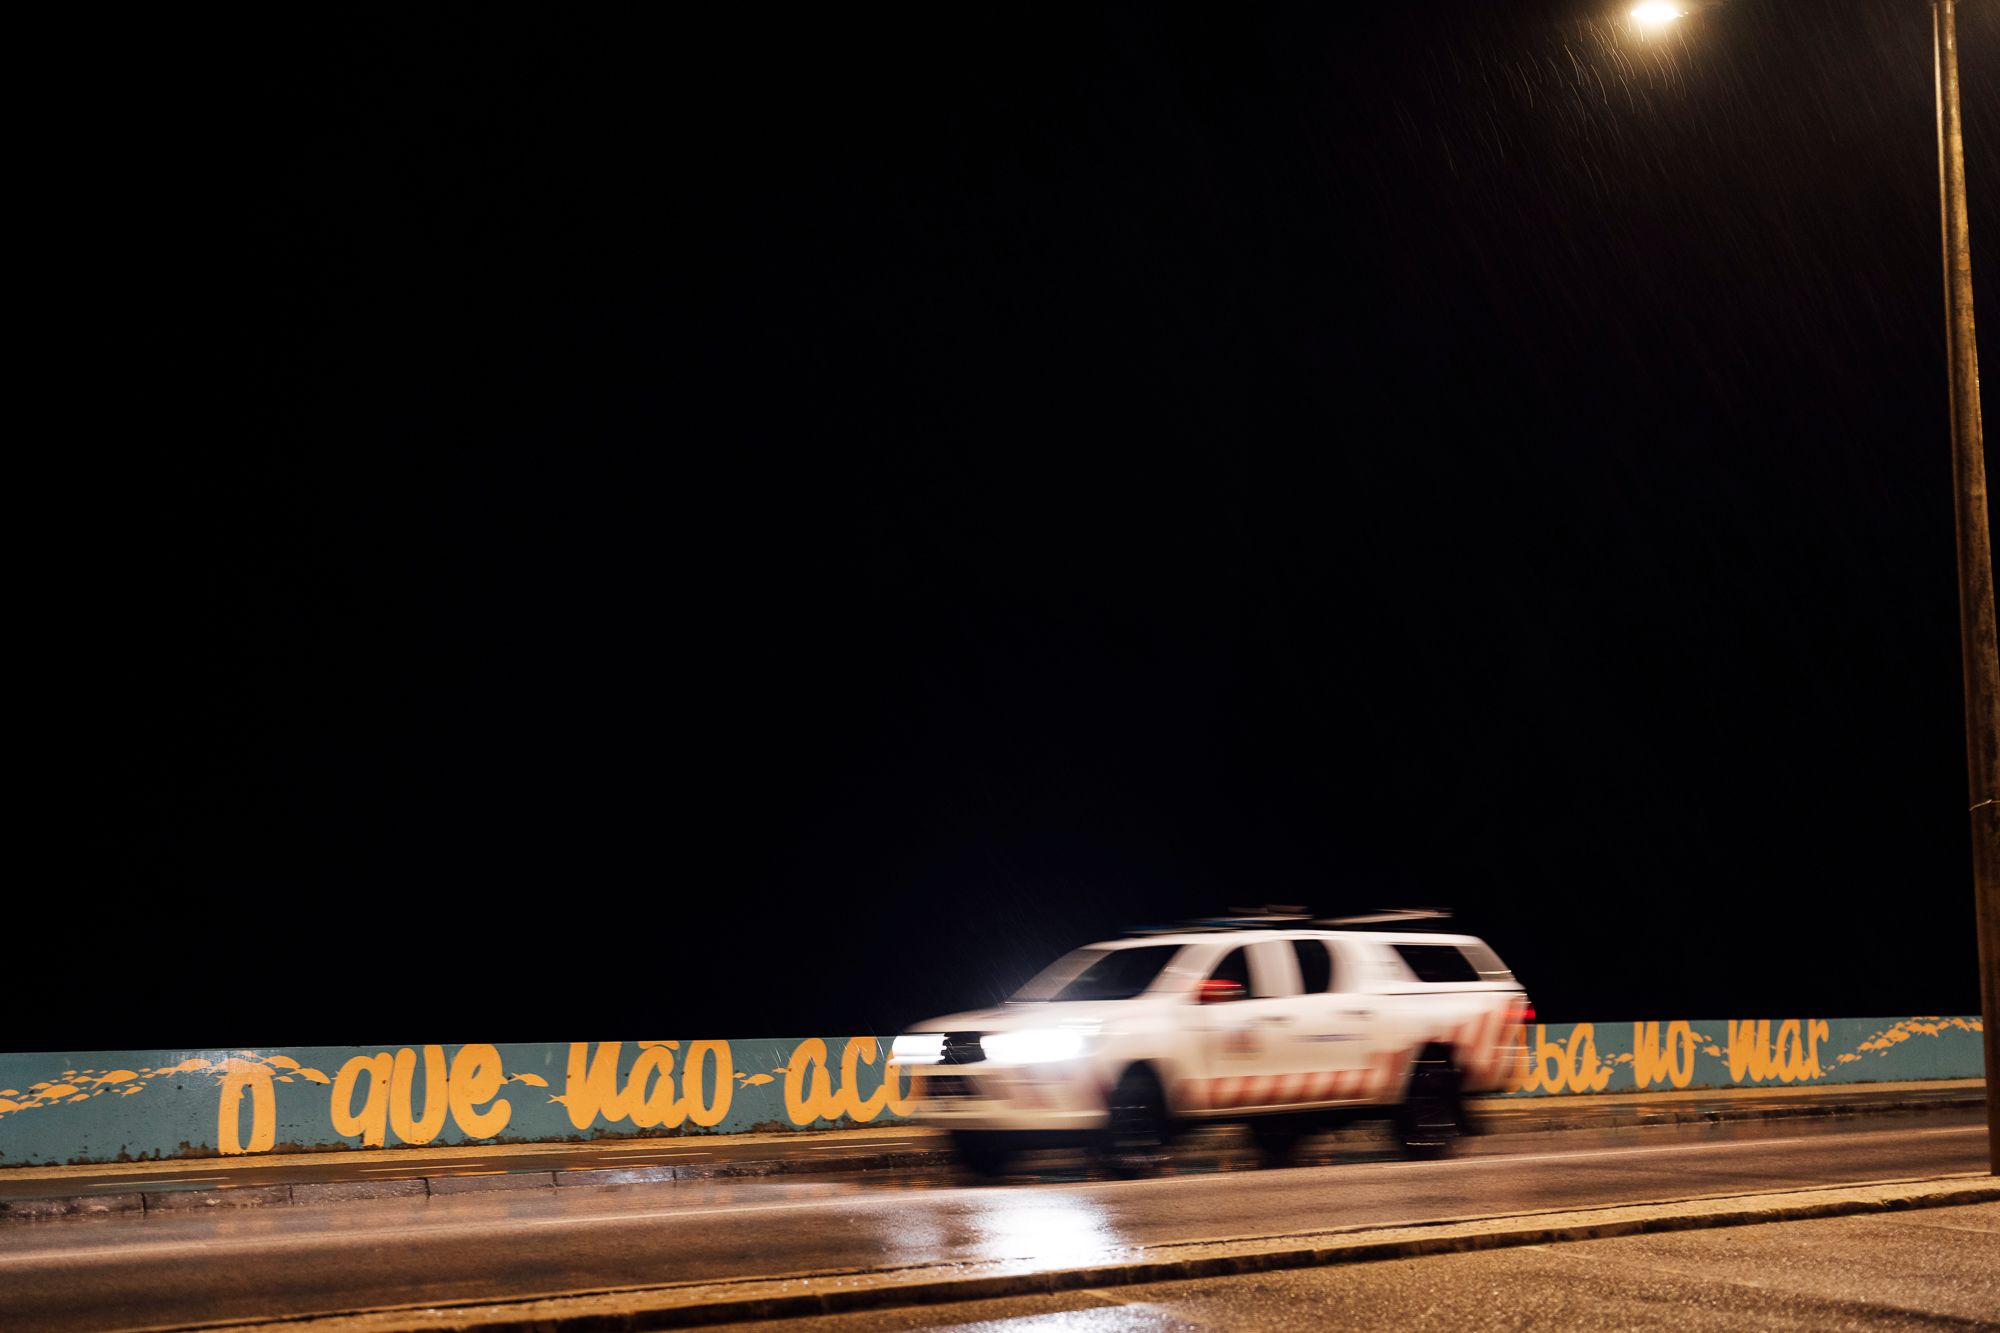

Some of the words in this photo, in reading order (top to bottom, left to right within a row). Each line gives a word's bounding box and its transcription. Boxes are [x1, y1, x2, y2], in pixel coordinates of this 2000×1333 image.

[330, 1043, 511, 1147] que
[564, 1039, 733, 1130] não
[1633, 1020, 1695, 1089] no
[1728, 1018, 1829, 1083] mar
